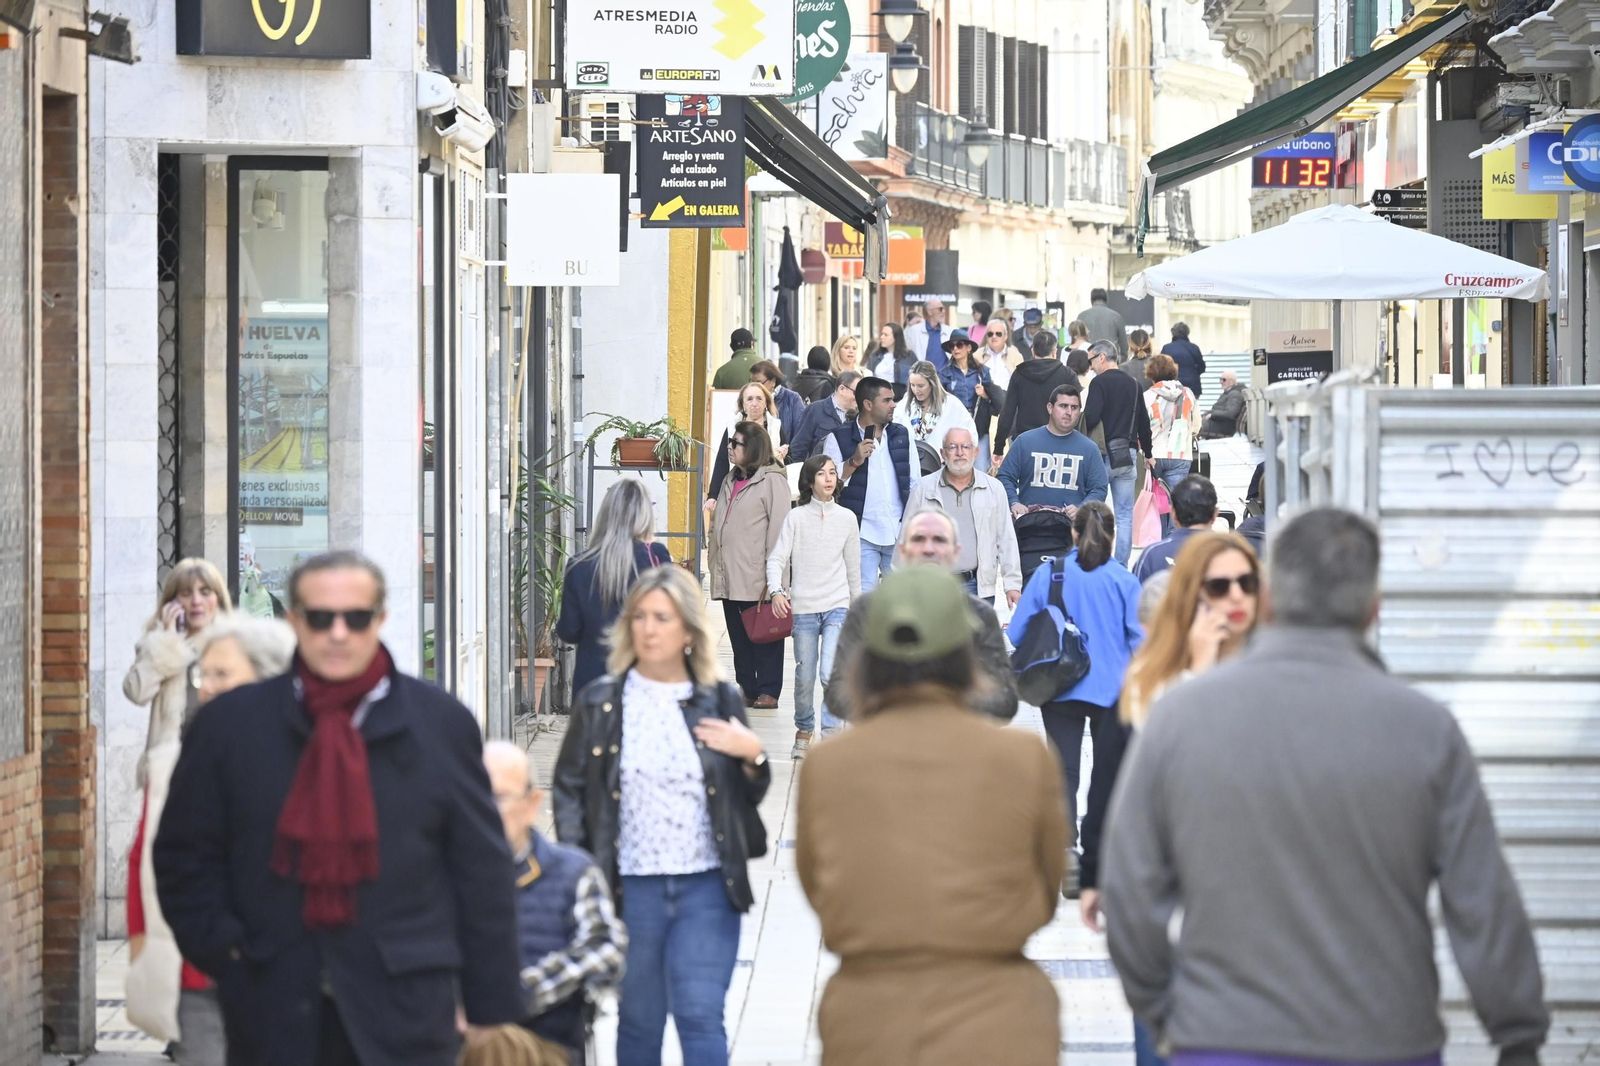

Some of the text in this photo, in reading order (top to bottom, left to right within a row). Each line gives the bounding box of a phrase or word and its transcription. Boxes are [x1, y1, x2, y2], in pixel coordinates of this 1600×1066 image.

[796, 0, 836, 12] iendas
[594, 10, 698, 22] ATRESMEDIA
[655, 24, 698, 35] RADIO
[797, 82, 815, 95] 1915
[651, 117, 669, 128] EL
[650, 127, 737, 145] ARTESANO
[1292, 138, 1331, 150] urbano
[662, 150, 725, 163] Arreglo y venta
[1563, 147, 1600, 162] DI
[670, 163, 717, 174] del calzado
[660, 177, 727, 190] Artículos en piel
[1492, 171, 1515, 185] MÁS
[684, 204, 740, 216] EN GALERIA
[886, 271, 919, 283] range
[248, 326, 321, 341] HUELVA
[239, 350, 309, 362] ndrés Espuelas
[239, 480, 321, 493] enes exclusivas
[264, 494, 328, 509] personalizad
[245, 511, 273, 521] ELLOW
